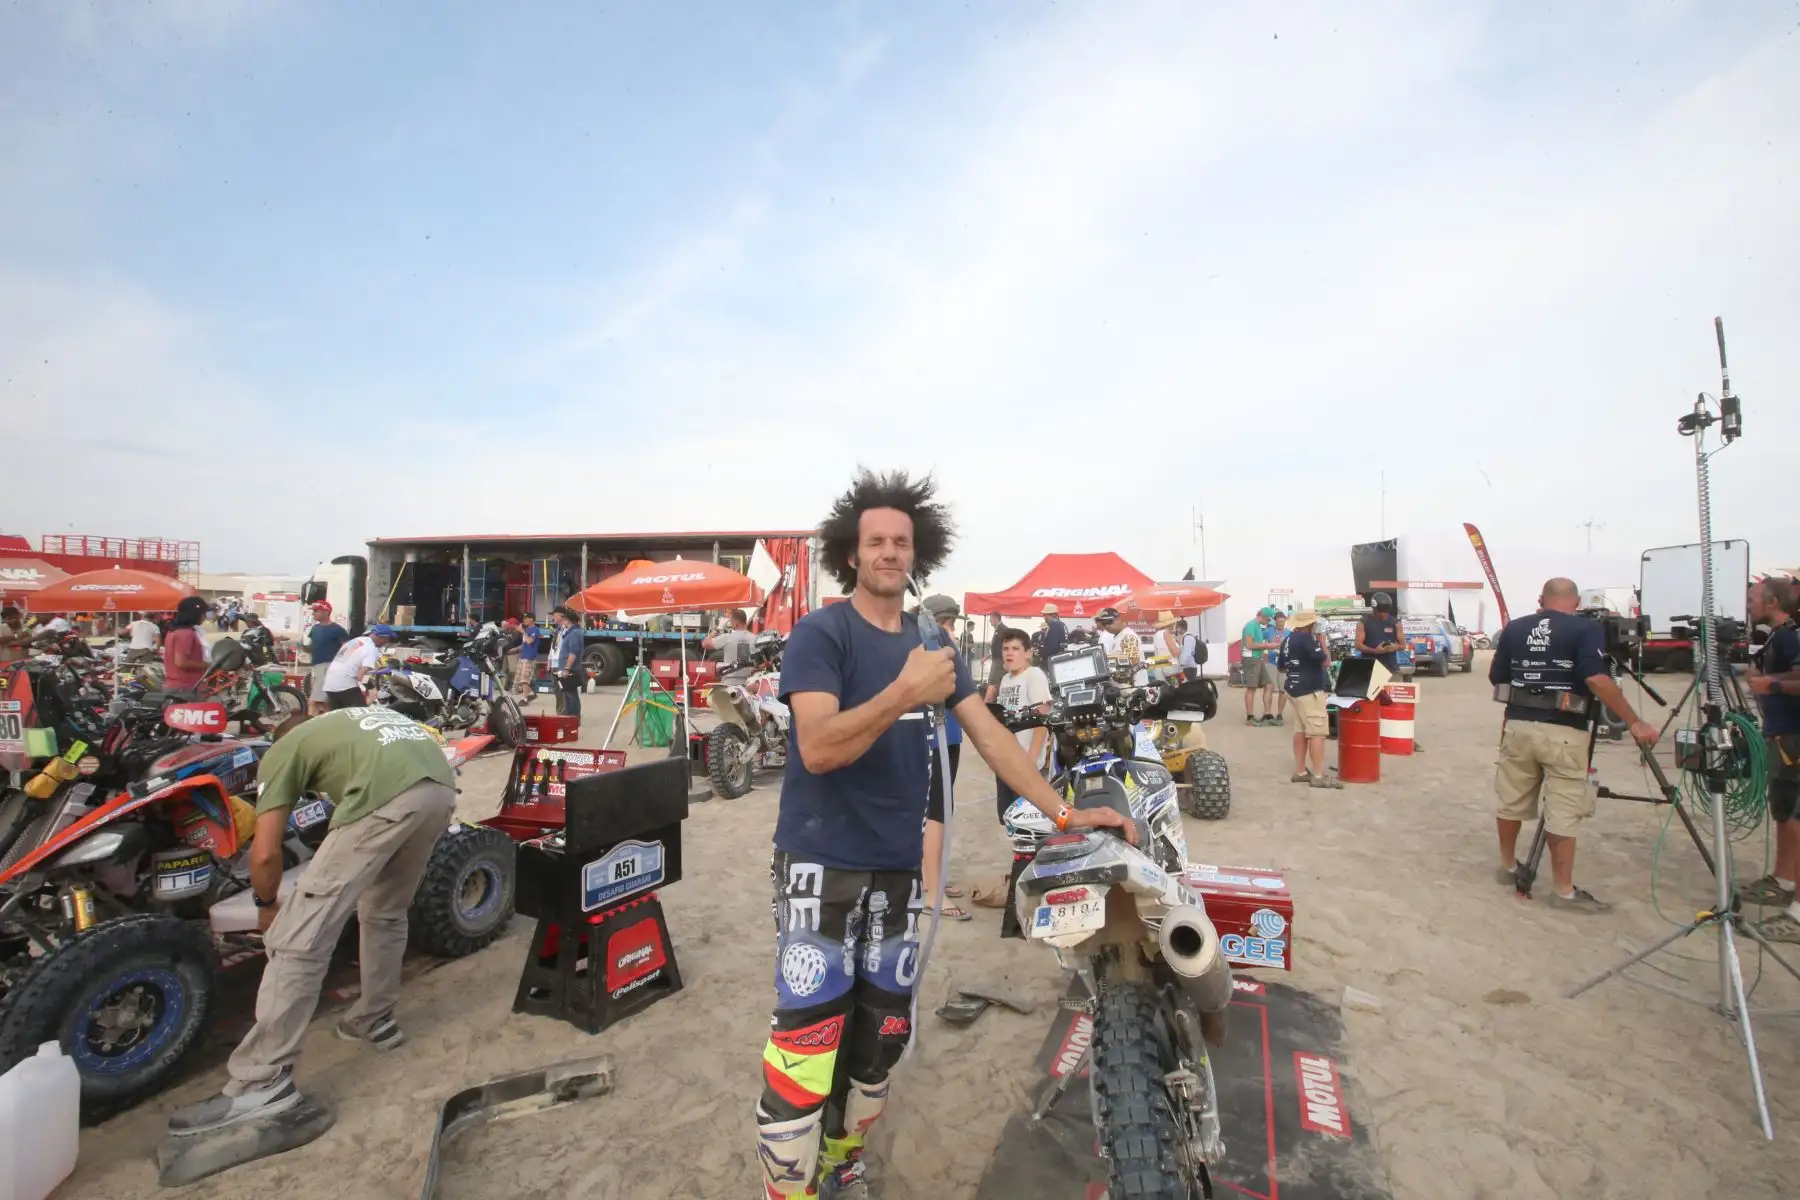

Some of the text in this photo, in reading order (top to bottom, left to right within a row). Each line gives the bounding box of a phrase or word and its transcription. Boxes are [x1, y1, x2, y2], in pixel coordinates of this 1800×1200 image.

[631, 572, 706, 585] MOTUL
[1032, 584, 1133, 597] ORIGINAL
[614, 857, 636, 880] A51
[618, 945, 654, 968] ORIGINAL
[1220, 933, 1286, 963] GEE
[1300, 1056, 1344, 1132] MOTUL
